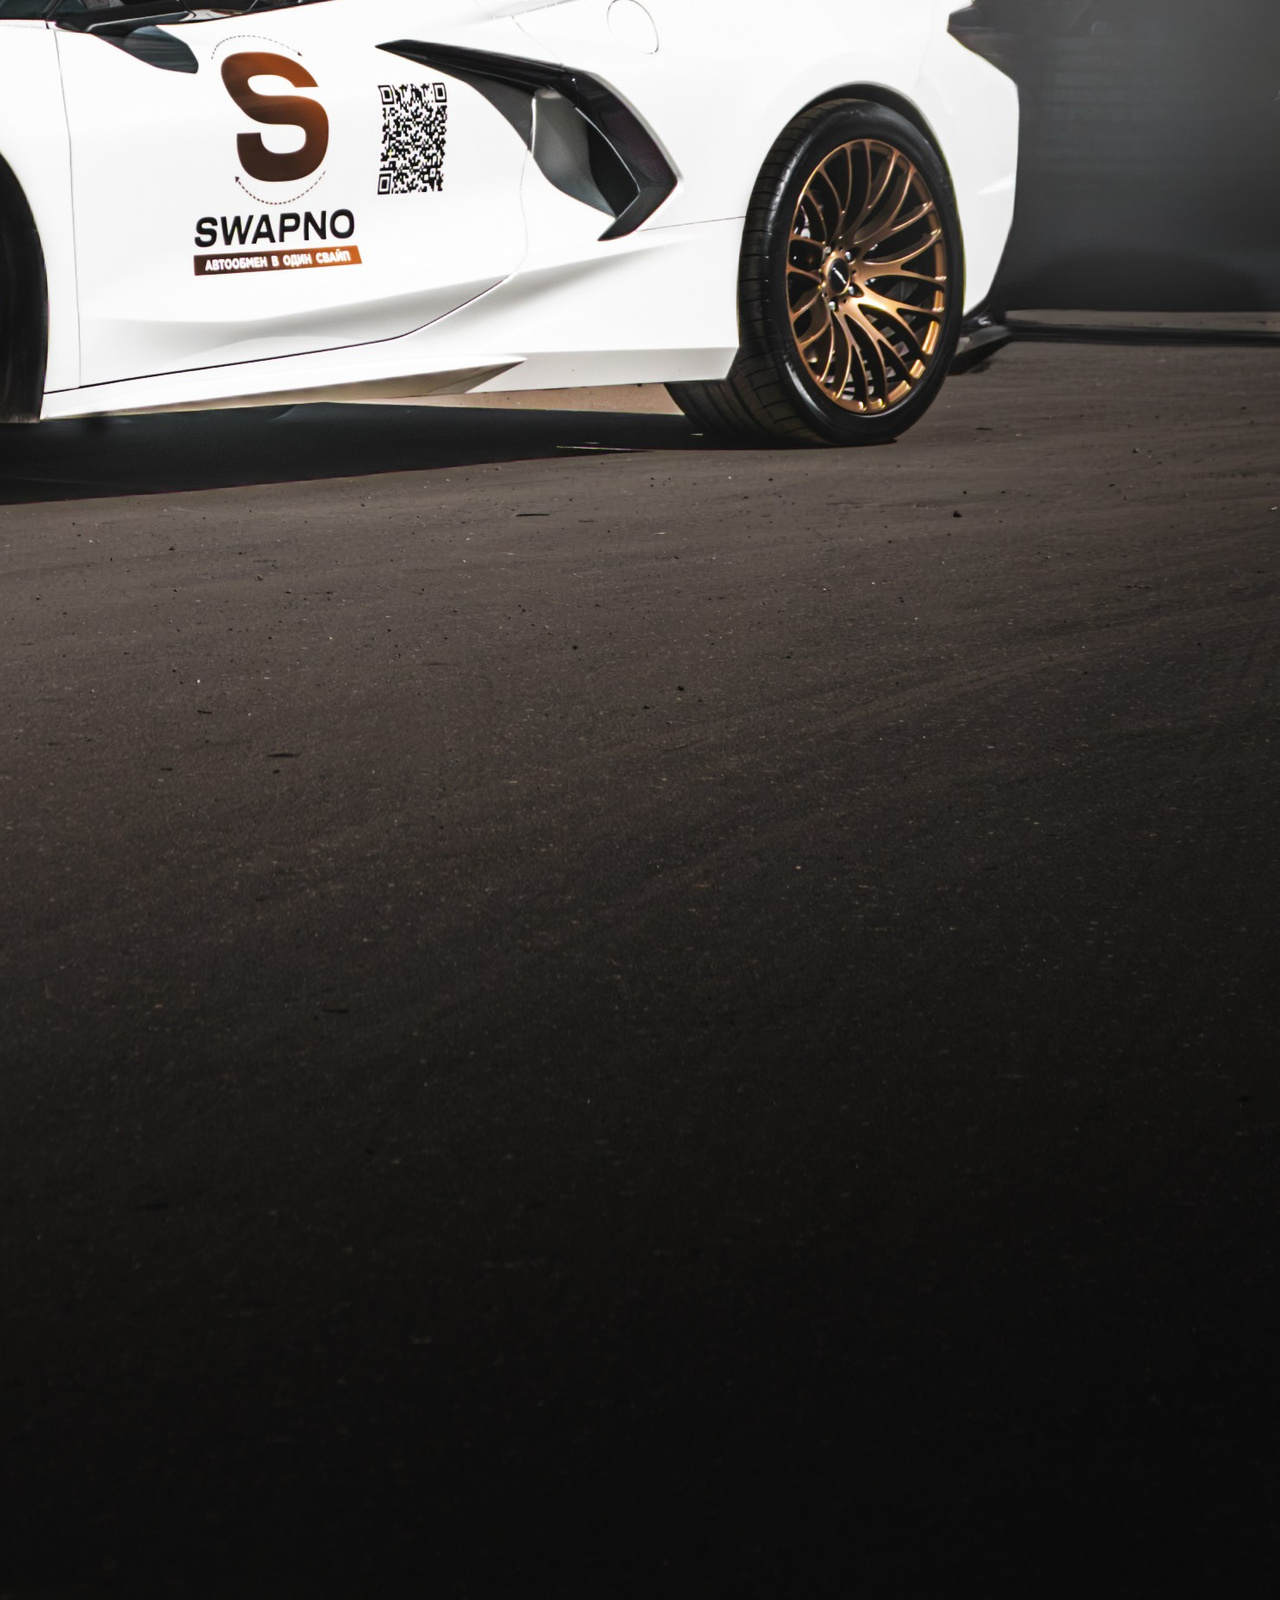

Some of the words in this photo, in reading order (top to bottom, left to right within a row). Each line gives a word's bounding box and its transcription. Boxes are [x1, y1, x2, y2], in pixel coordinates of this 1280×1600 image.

[221, 52, 329, 182] S
[194, 209, 355, 247] SWAPNO
[205, 256, 268, 271] АВТООБМЕН
[271, 255, 279, 267] В
[283, 253, 312, 267] ОДИН
[316, 249, 351, 263] СВАЙП
